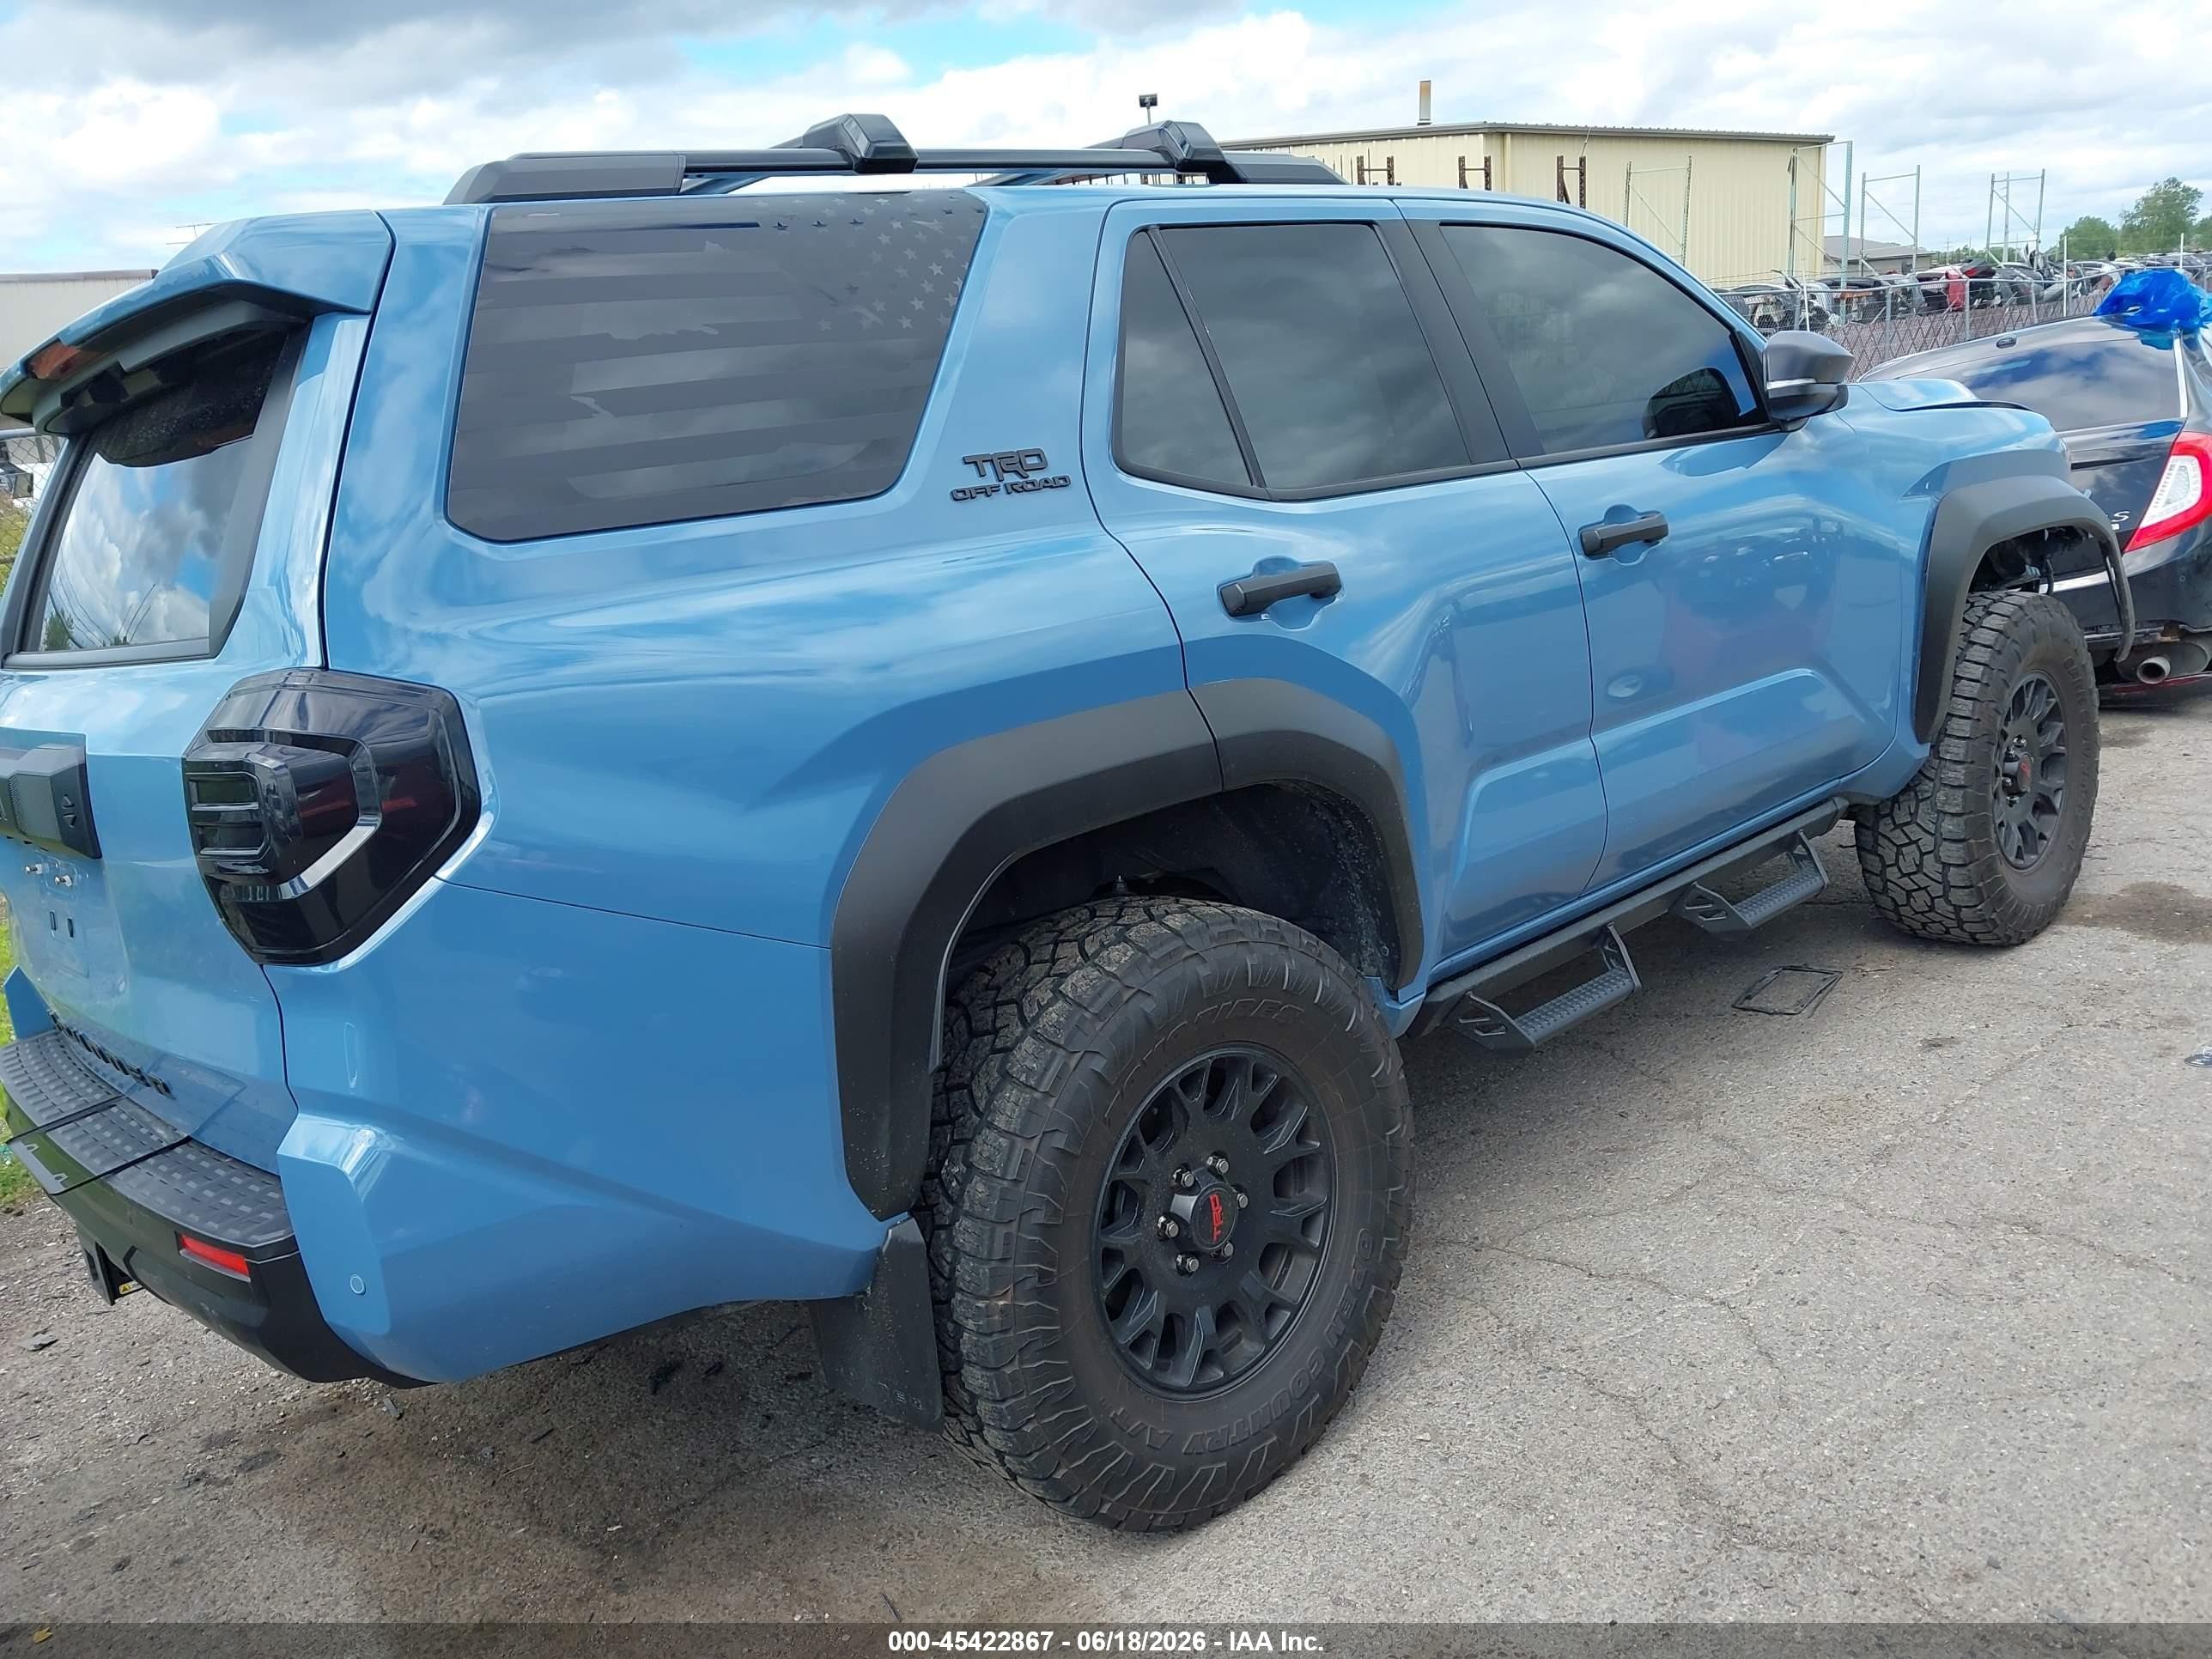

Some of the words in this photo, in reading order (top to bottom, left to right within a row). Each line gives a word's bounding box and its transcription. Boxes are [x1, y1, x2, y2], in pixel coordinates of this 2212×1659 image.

[963, 447, 1048, 482] TRD
[950, 483, 1001, 501] OFF
[1003, 474, 1073, 495] ROAD
[1209, 1194, 1224, 1243] TRD
[1325, 1228, 1374, 1347] OPEN
